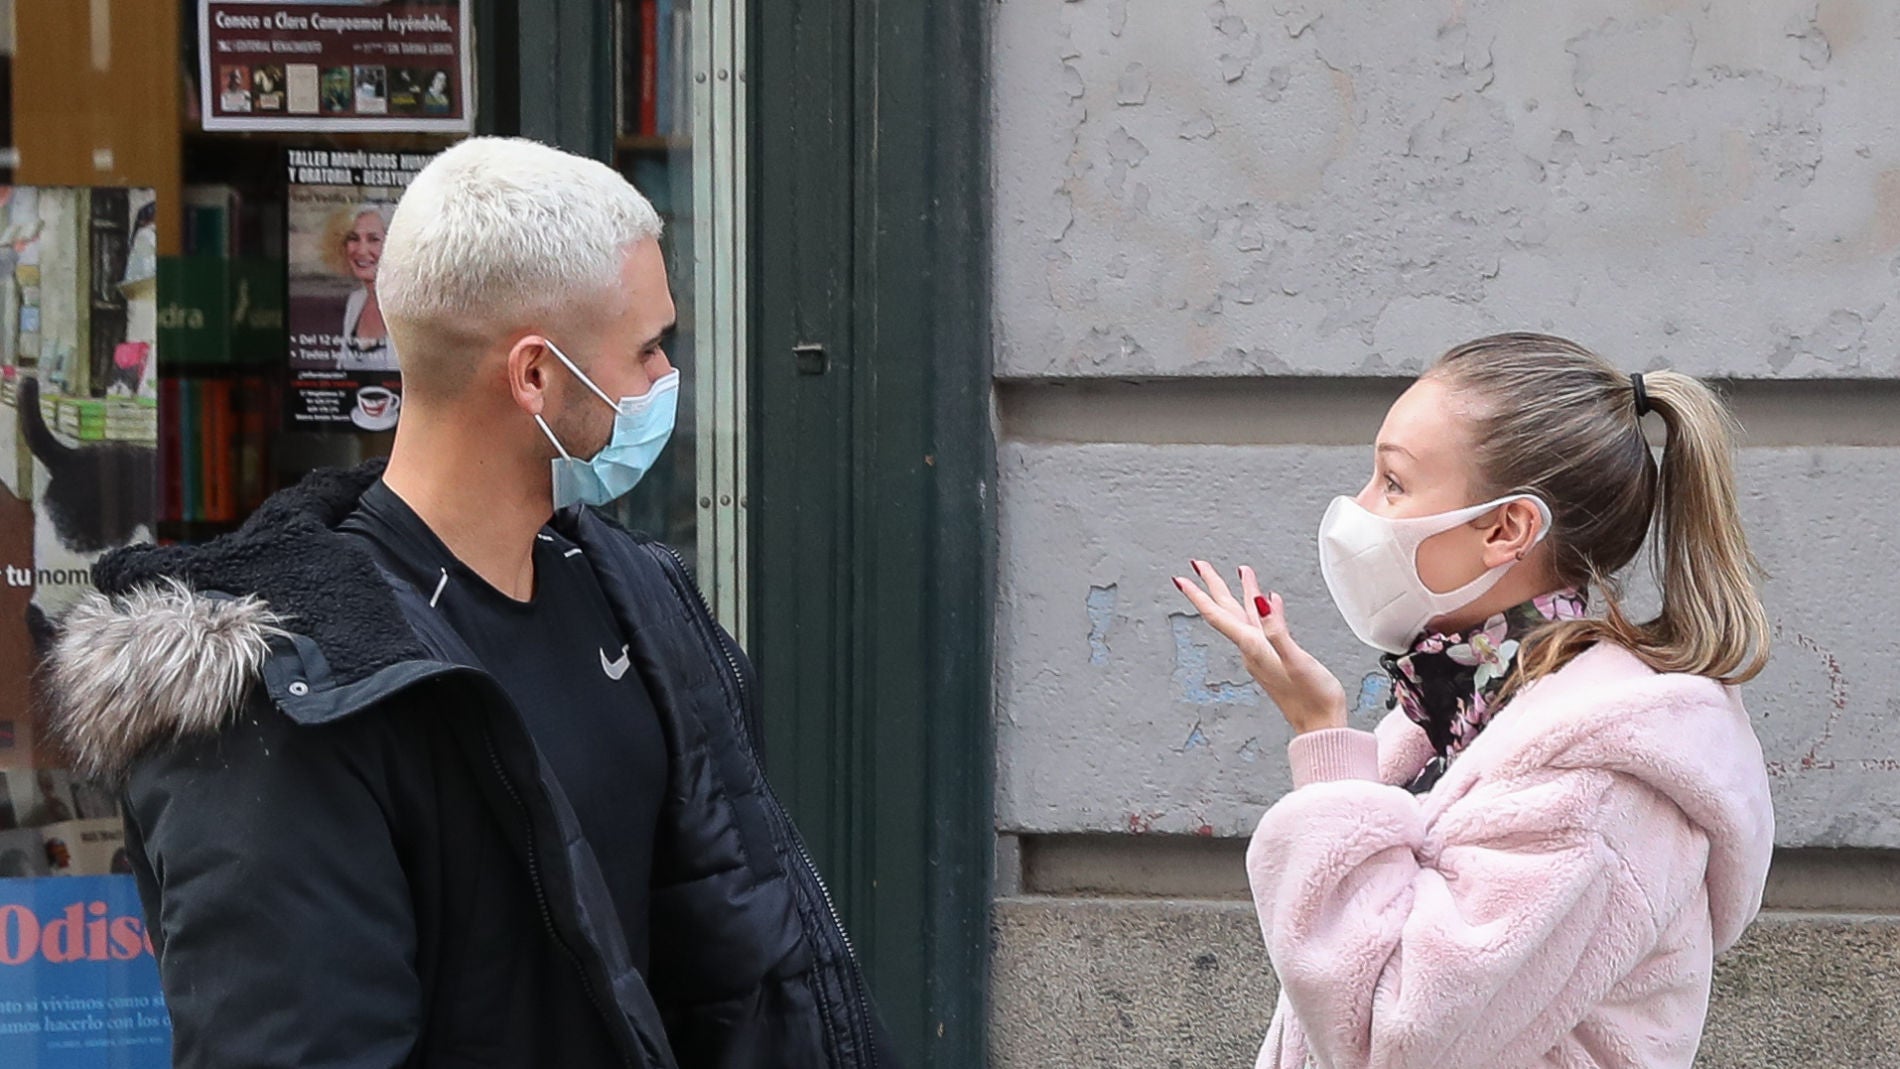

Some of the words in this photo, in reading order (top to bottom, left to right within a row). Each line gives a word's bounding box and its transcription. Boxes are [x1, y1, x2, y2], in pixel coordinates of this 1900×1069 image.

[215, 10, 260, 29] Conoce
[263, 16, 272, 29] a
[275, 11, 307, 30] Clara
[311, 12, 383, 34] Campoamor
[288, 150, 328, 167] TALLER
[330, 149, 398, 170] MONÓLOGOS
[288, 167, 296, 183] Y
[298, 167, 353, 184] ORATORIA
[300, 334, 317, 345] Del
[319, 334, 330, 346] 12
[300, 349, 330, 360] Todos
[6, 564, 32, 587] tu
[38, 565, 94, 586] nom
[41, 995, 104, 1012] vivimos
[107, 996, 149, 1009] como
[44, 1014, 102, 1032] hacerlo
[107, 1017, 134, 1030] con
[137, 1011, 158, 1027] los
